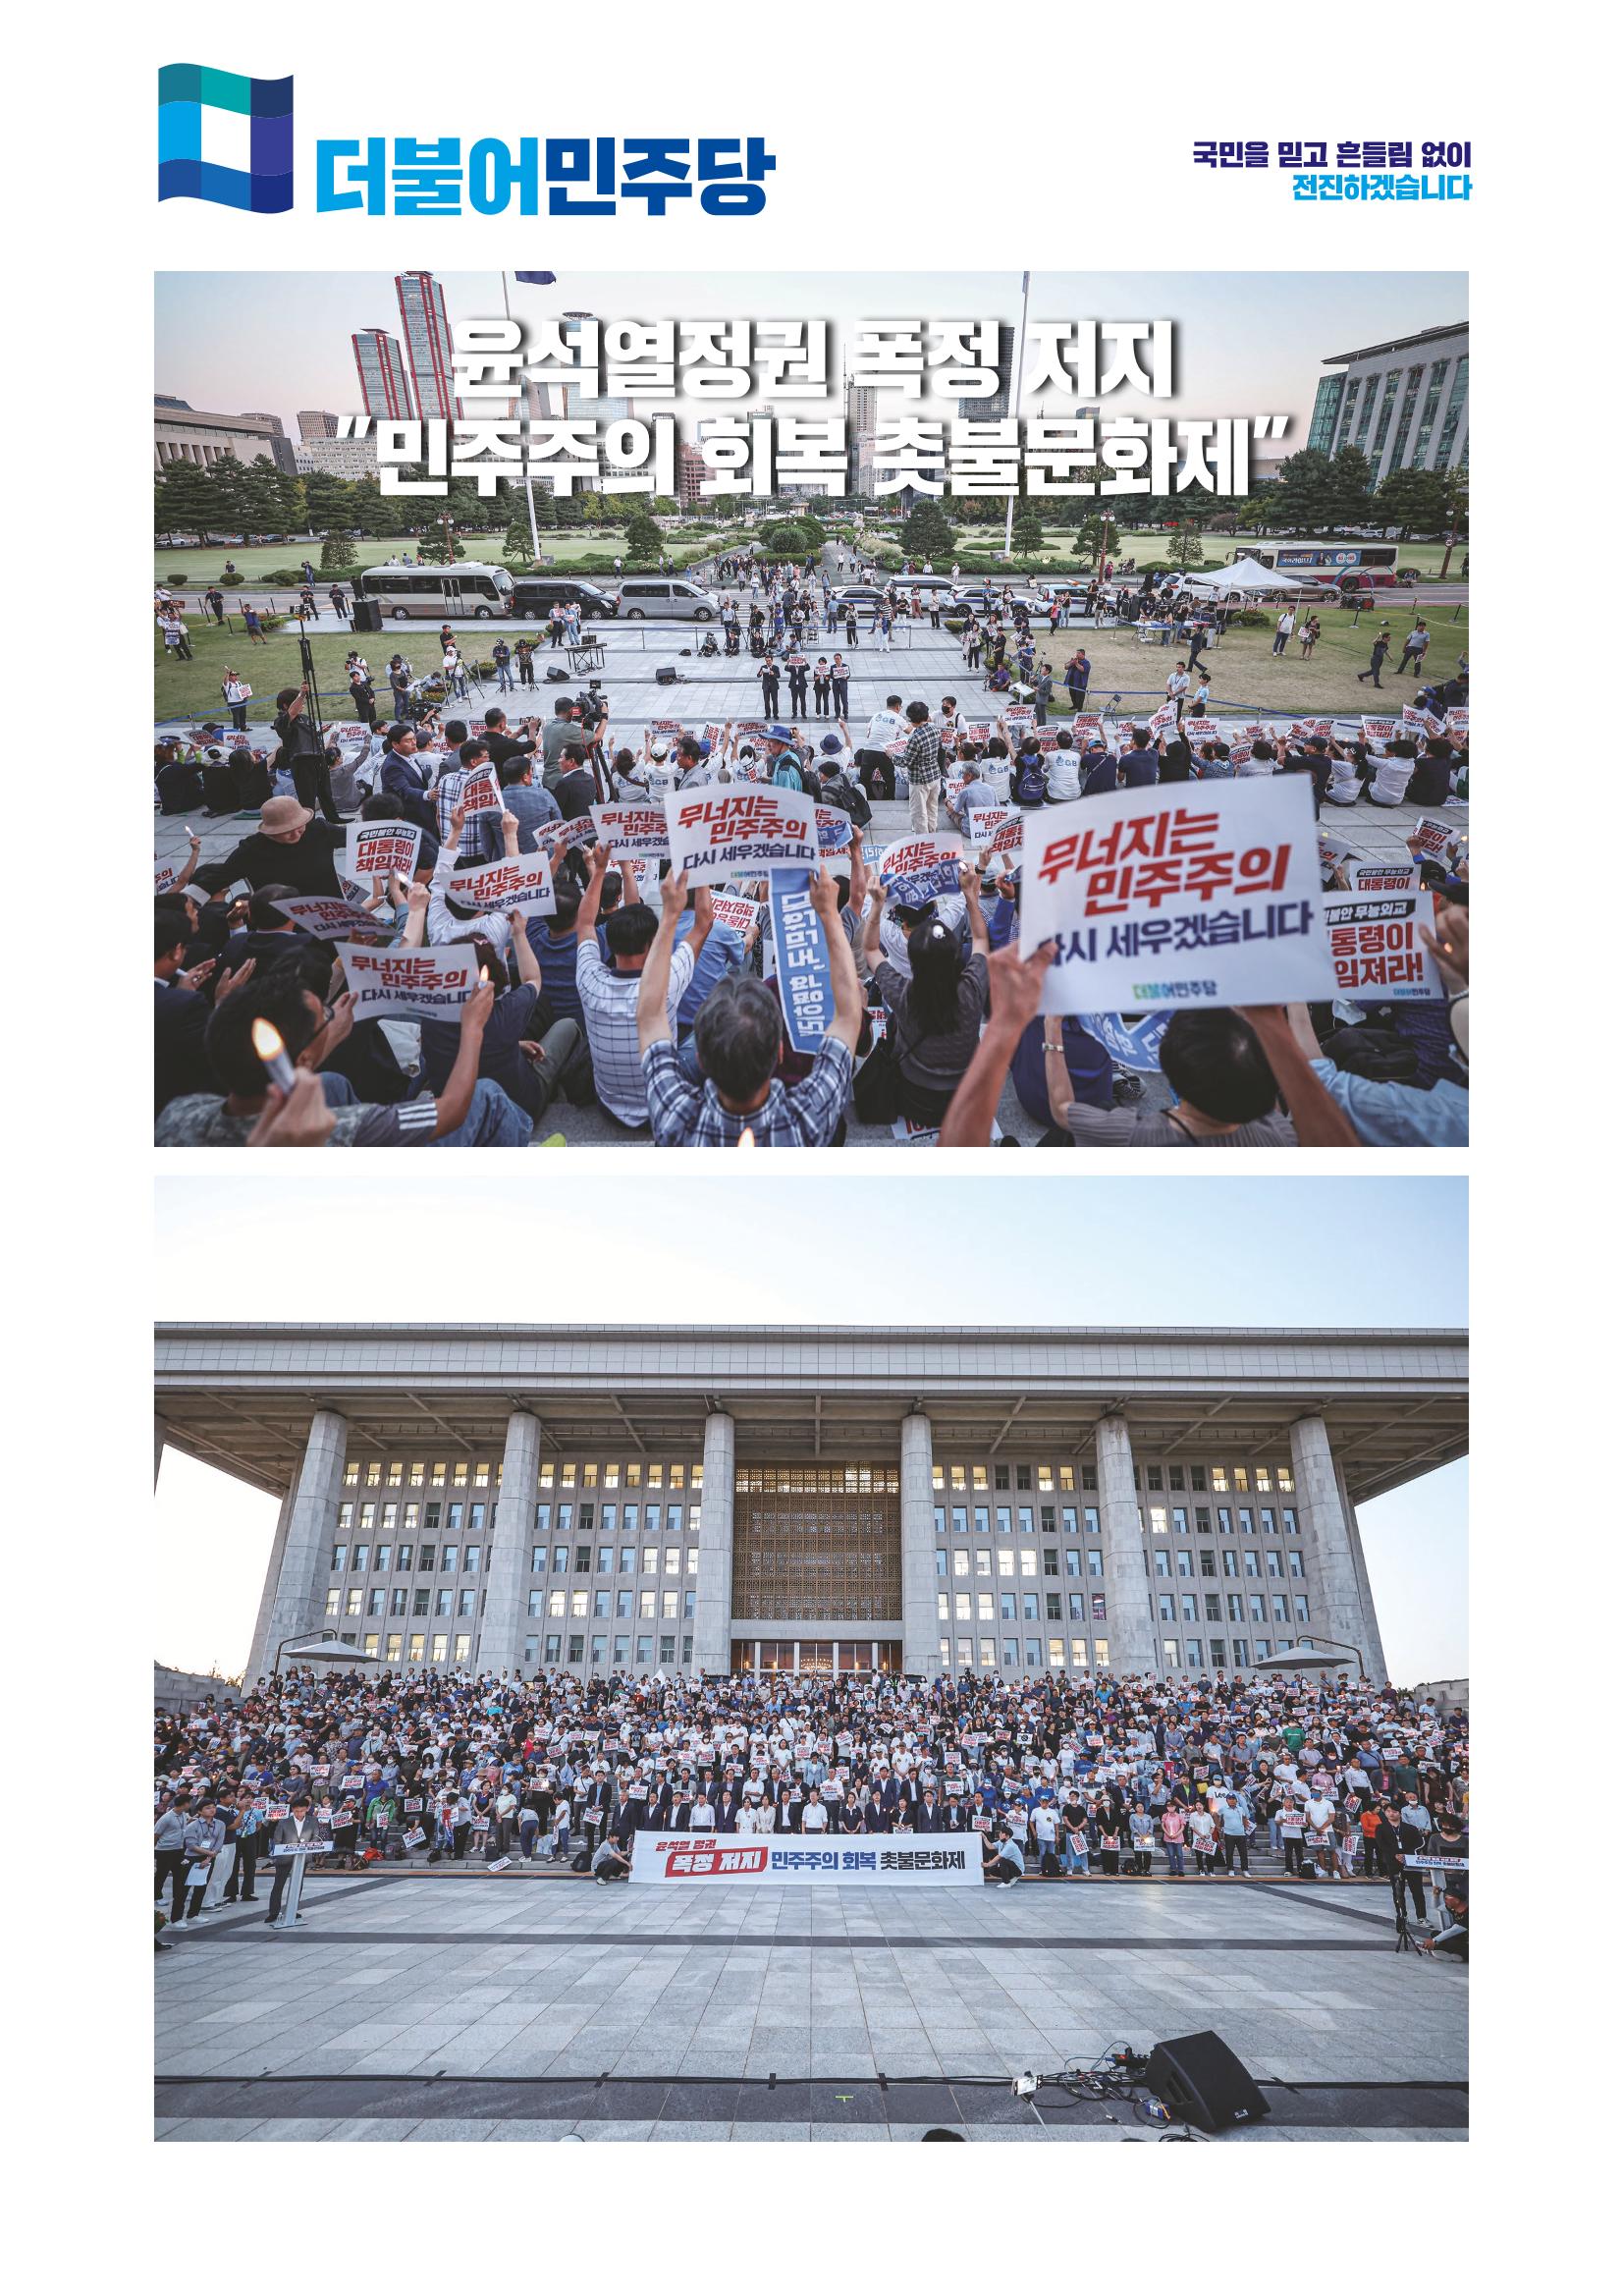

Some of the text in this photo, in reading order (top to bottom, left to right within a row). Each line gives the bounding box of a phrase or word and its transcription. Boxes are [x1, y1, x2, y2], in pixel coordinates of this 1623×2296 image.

[463, 779, 493, 799] 대통
[462, 792, 502, 813] 책임
[677, 795, 779, 829] 무너지는
[601, 810, 666, 826] 무너지는
[623, 823, 668, 837] 민주주
[710, 819, 808, 845] 민주주의
[358, 840, 414, 857] 대통령이
[608, 837, 670, 848] 다시 세우겠습
[1038, 808, 1219, 884] 무너지는
[682, 844, 816, 870] 다시 세우겠습니다
[883, 842, 935, 873] 무너지는
[450, 865, 520, 892] 무너지는
[473, 871, 543, 902] 민주주의
[1084, 844, 1292, 917] 민주주의
[1358, 877, 1411, 891] 대통령이
[1325, 901, 1408, 923] 불안 무능외교
[1107, 901, 1315, 957] 세우겠습니다
[1328, 922, 1414, 957] 통령이
[352, 956, 435, 974] 무너지는
[1333, 953, 1424, 990] 임져라!
[381, 969, 467, 990] 민주주의
[361, 989, 391, 1002] 다시
[1133, 981, 1218, 1001] 더불어민주당
[672, 1850, 966, 1873] 폭정 저지 민주주의 회복 촛불문화제
